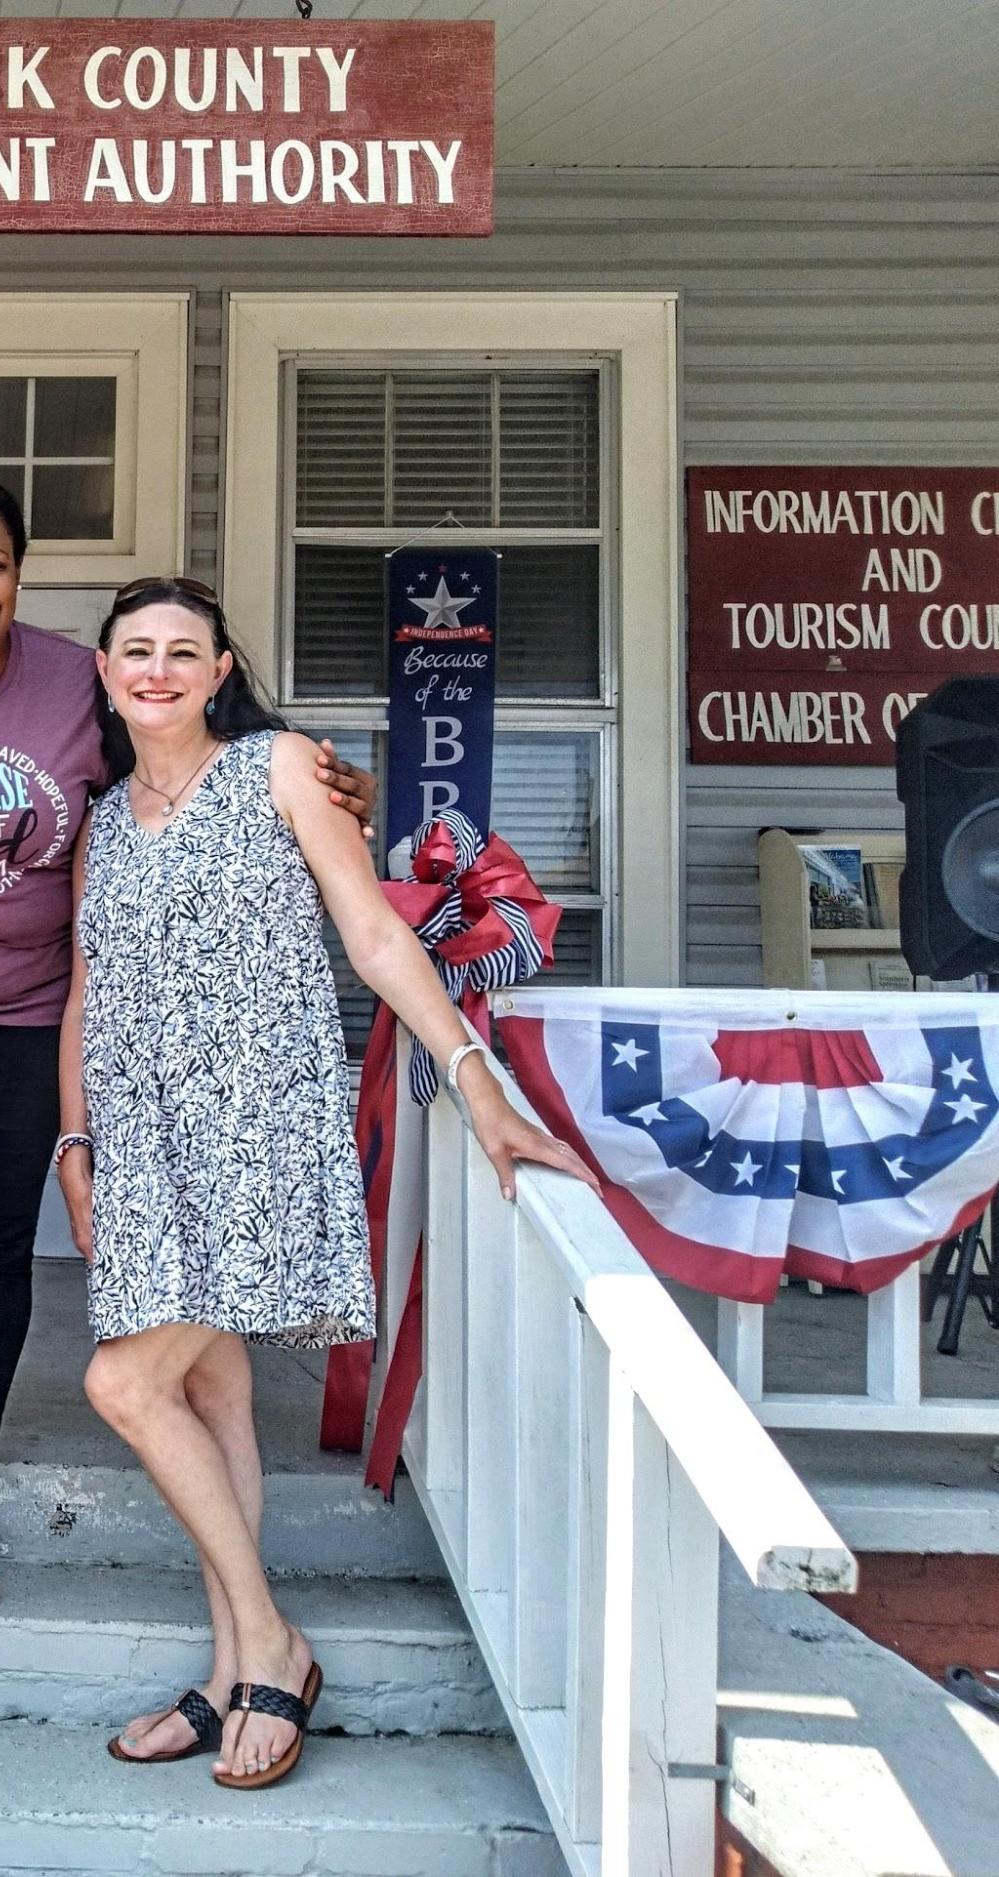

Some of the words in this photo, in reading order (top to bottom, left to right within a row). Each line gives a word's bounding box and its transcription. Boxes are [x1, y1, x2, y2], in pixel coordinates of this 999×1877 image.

[83, 45, 359, 114] COUNTY
[85, 138, 464, 206] AUTHORITY
[704, 489, 945, 536] INFORMATION
[970, 491, 999, 536] C
[861, 548, 942, 593] AND
[410, 627, 463, 640] INDEPENDENCE
[463, 626, 479, 637] DAY
[722, 602, 891, 650] TOURISM
[403, 645, 489, 675] Because
[414, 673, 440, 711] of
[442, 675, 473, 701] the
[698, 691, 872, 745] CHAMBER
[34, 769, 70, 830] HOPEFUL
